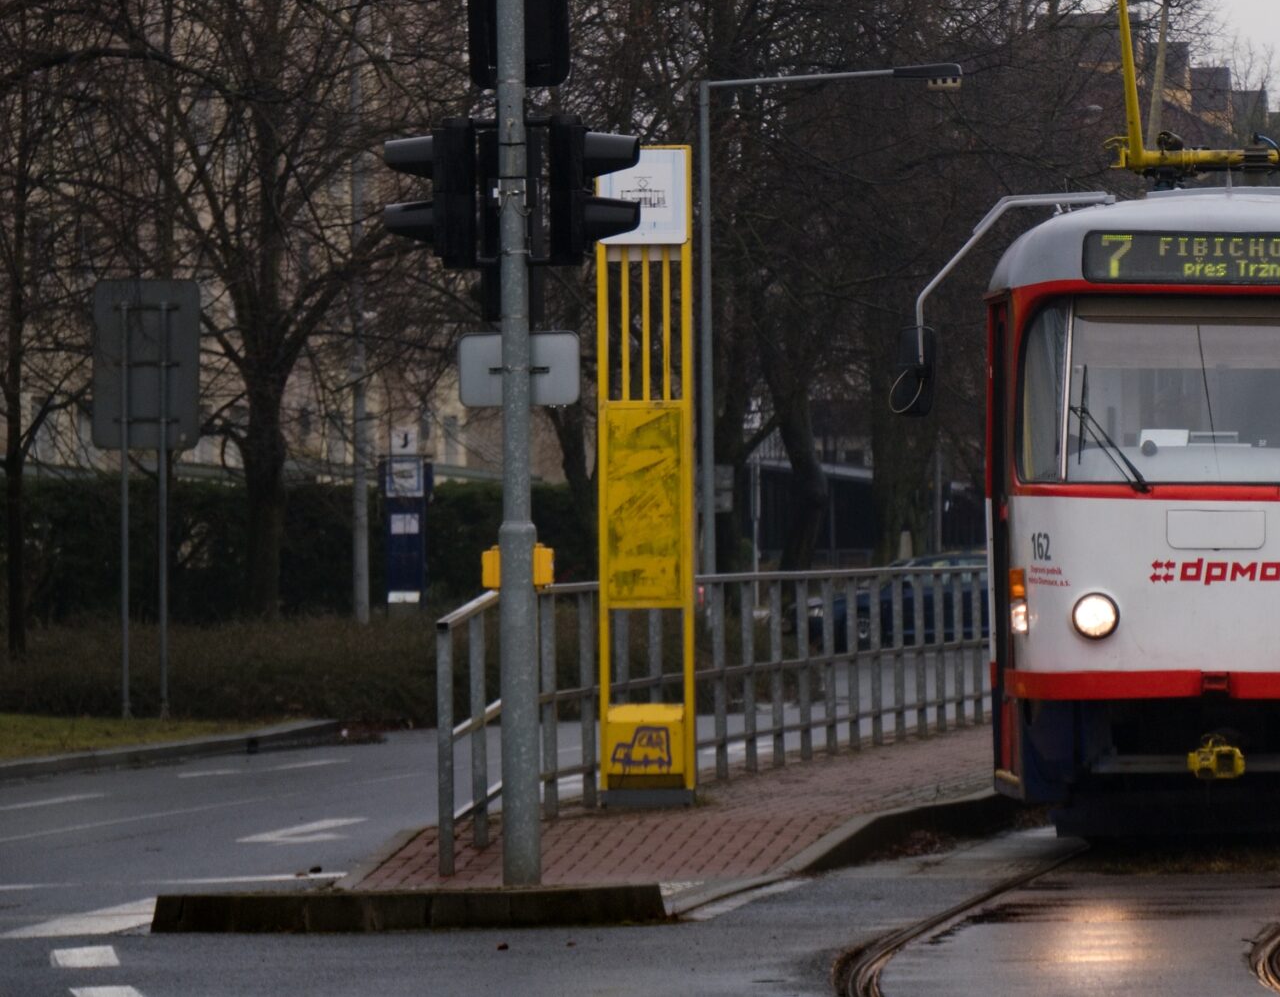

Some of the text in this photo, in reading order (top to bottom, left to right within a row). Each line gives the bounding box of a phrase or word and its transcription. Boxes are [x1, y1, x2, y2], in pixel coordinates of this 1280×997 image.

[1102, 235, 1132, 278] 7
[1183, 257, 1227, 277] přes
[1031, 532, 1051, 561] 162
